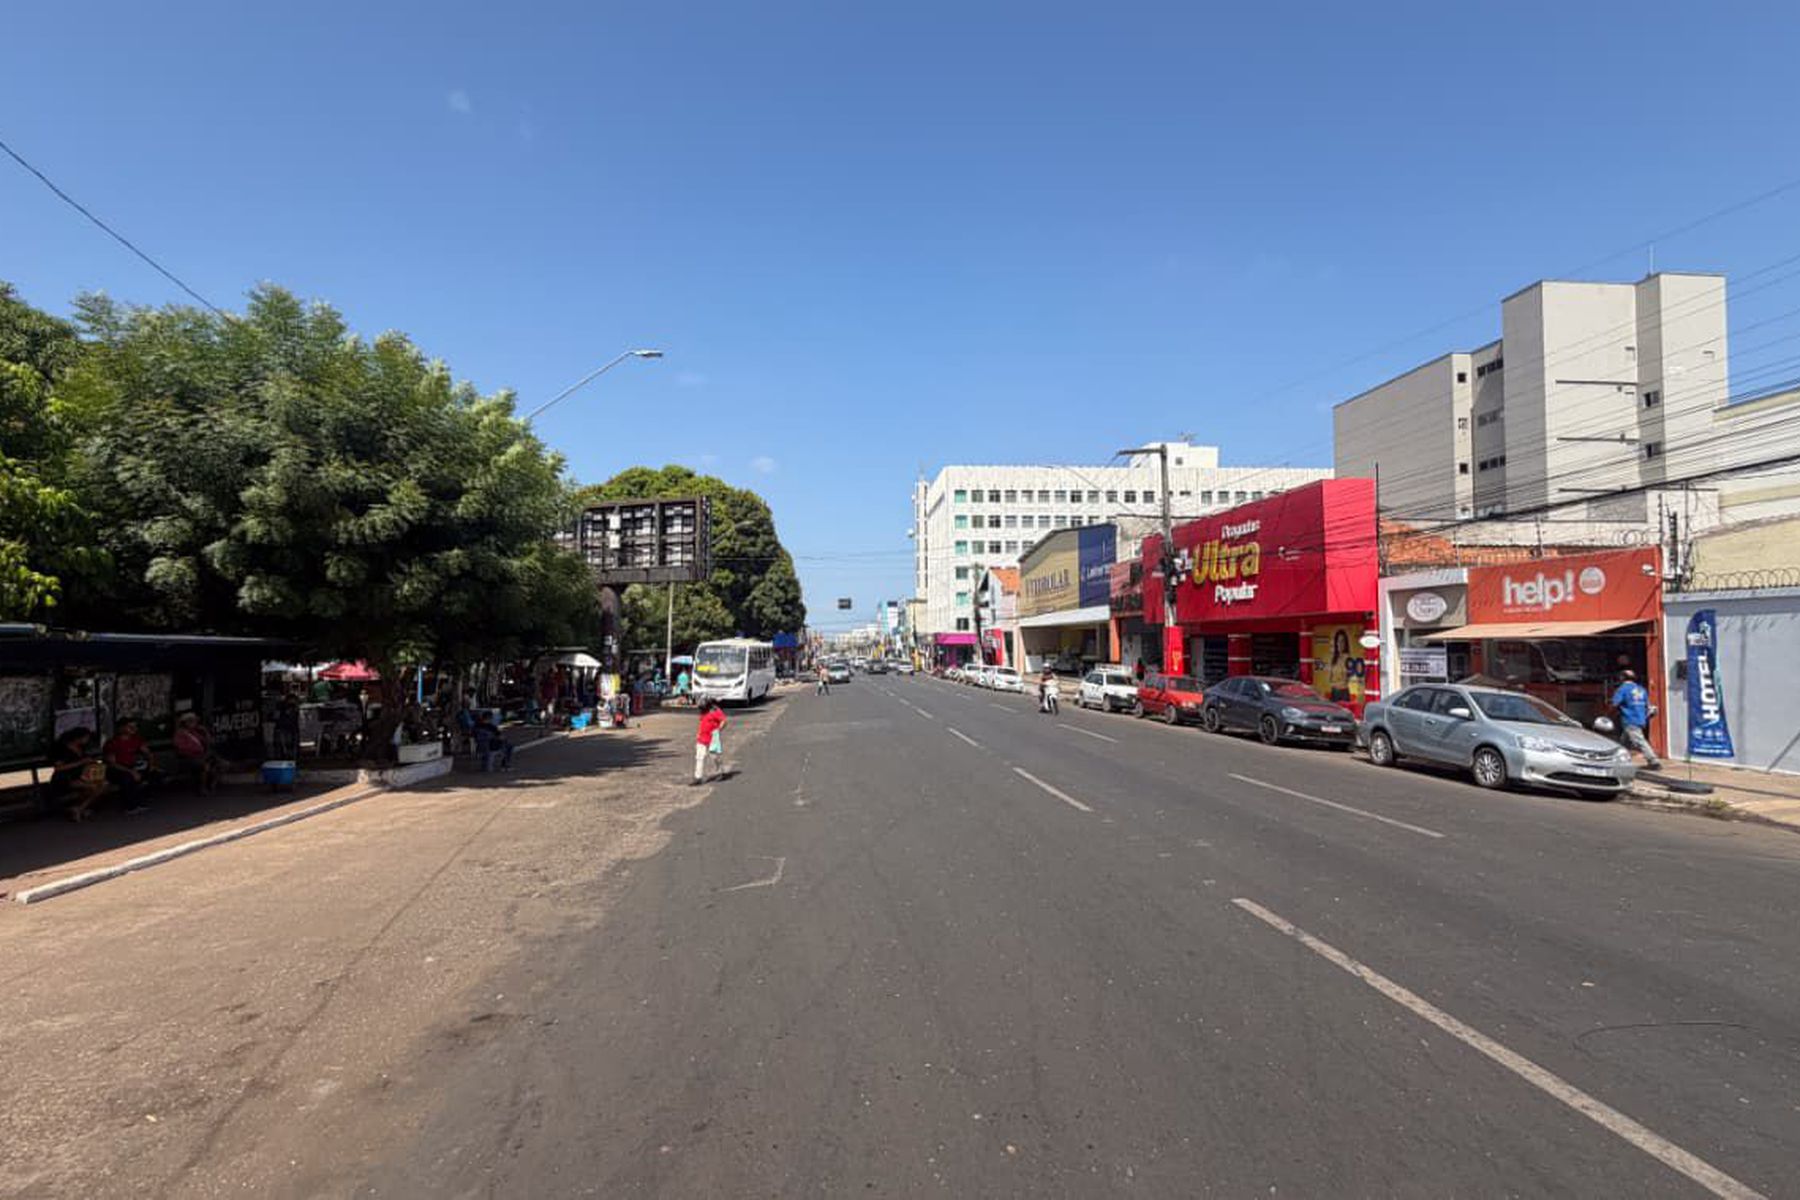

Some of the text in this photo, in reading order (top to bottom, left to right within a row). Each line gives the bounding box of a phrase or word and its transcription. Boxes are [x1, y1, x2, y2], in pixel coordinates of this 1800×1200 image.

[1191, 539, 1261, 585] Ultra
[1502, 567, 1575, 611] help!
[1698, 651, 1720, 722] HOTEL
